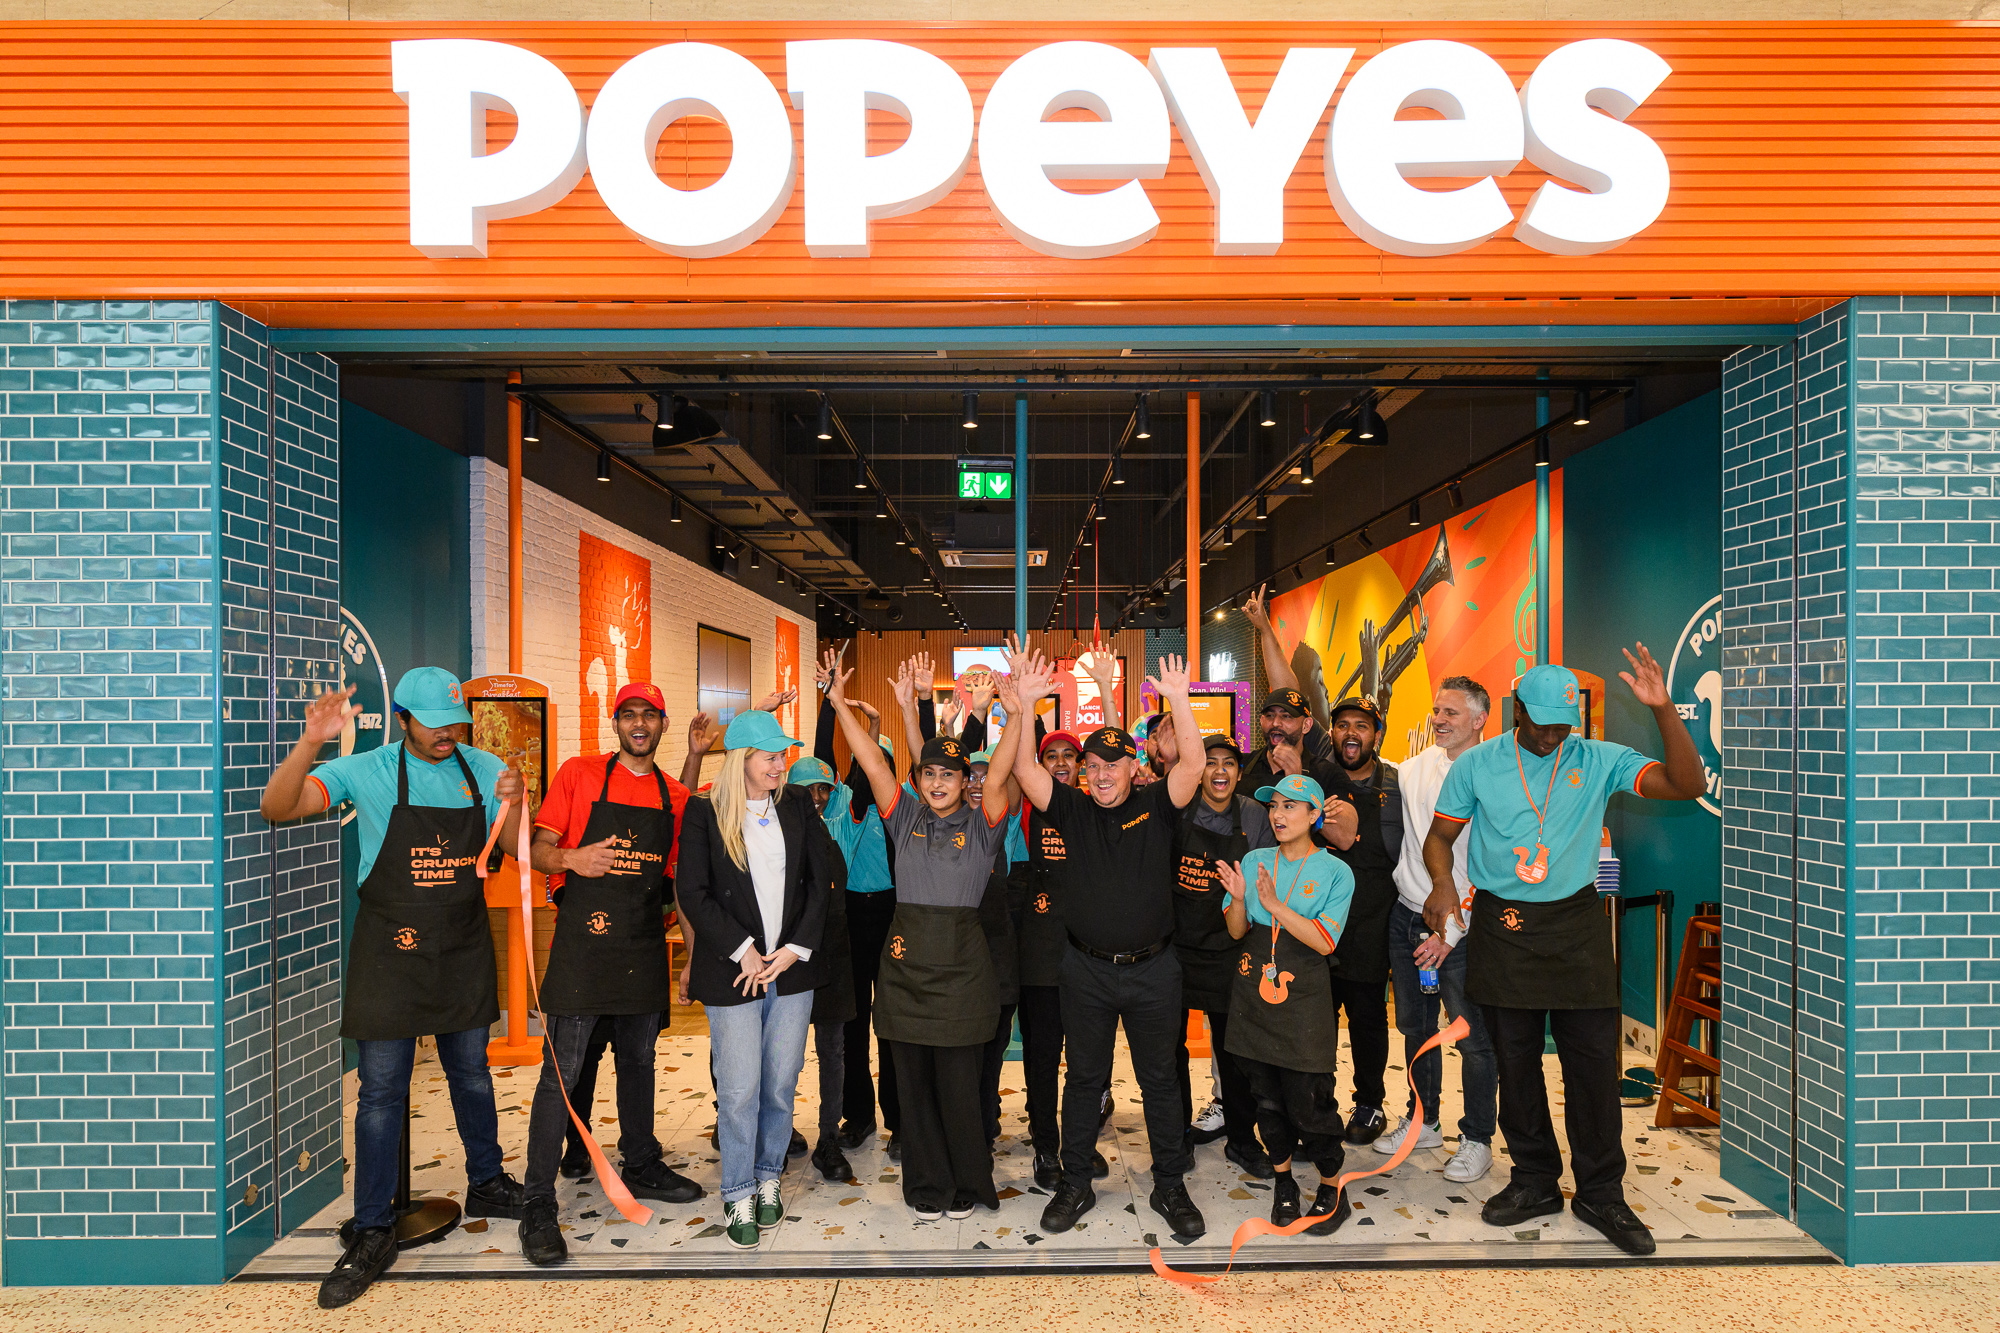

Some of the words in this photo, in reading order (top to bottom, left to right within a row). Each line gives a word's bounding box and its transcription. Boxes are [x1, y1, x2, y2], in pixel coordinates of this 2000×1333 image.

[358, 713, 382, 729] 1972
[1122, 812, 1149, 830] POPEYES
[411, 847, 442, 857] IT'S
[615, 849, 662, 863] RUNCH
[1042, 846, 1066, 855] TIM
[411, 855, 476, 868] CRUNCH
[614, 860, 641, 870] IME
[1181, 855, 1205, 867] IT'S
[411, 870, 455, 880] TIME
[1180, 865, 1222, 880] CRUNC
[1178, 873, 1209, 887] TIME
